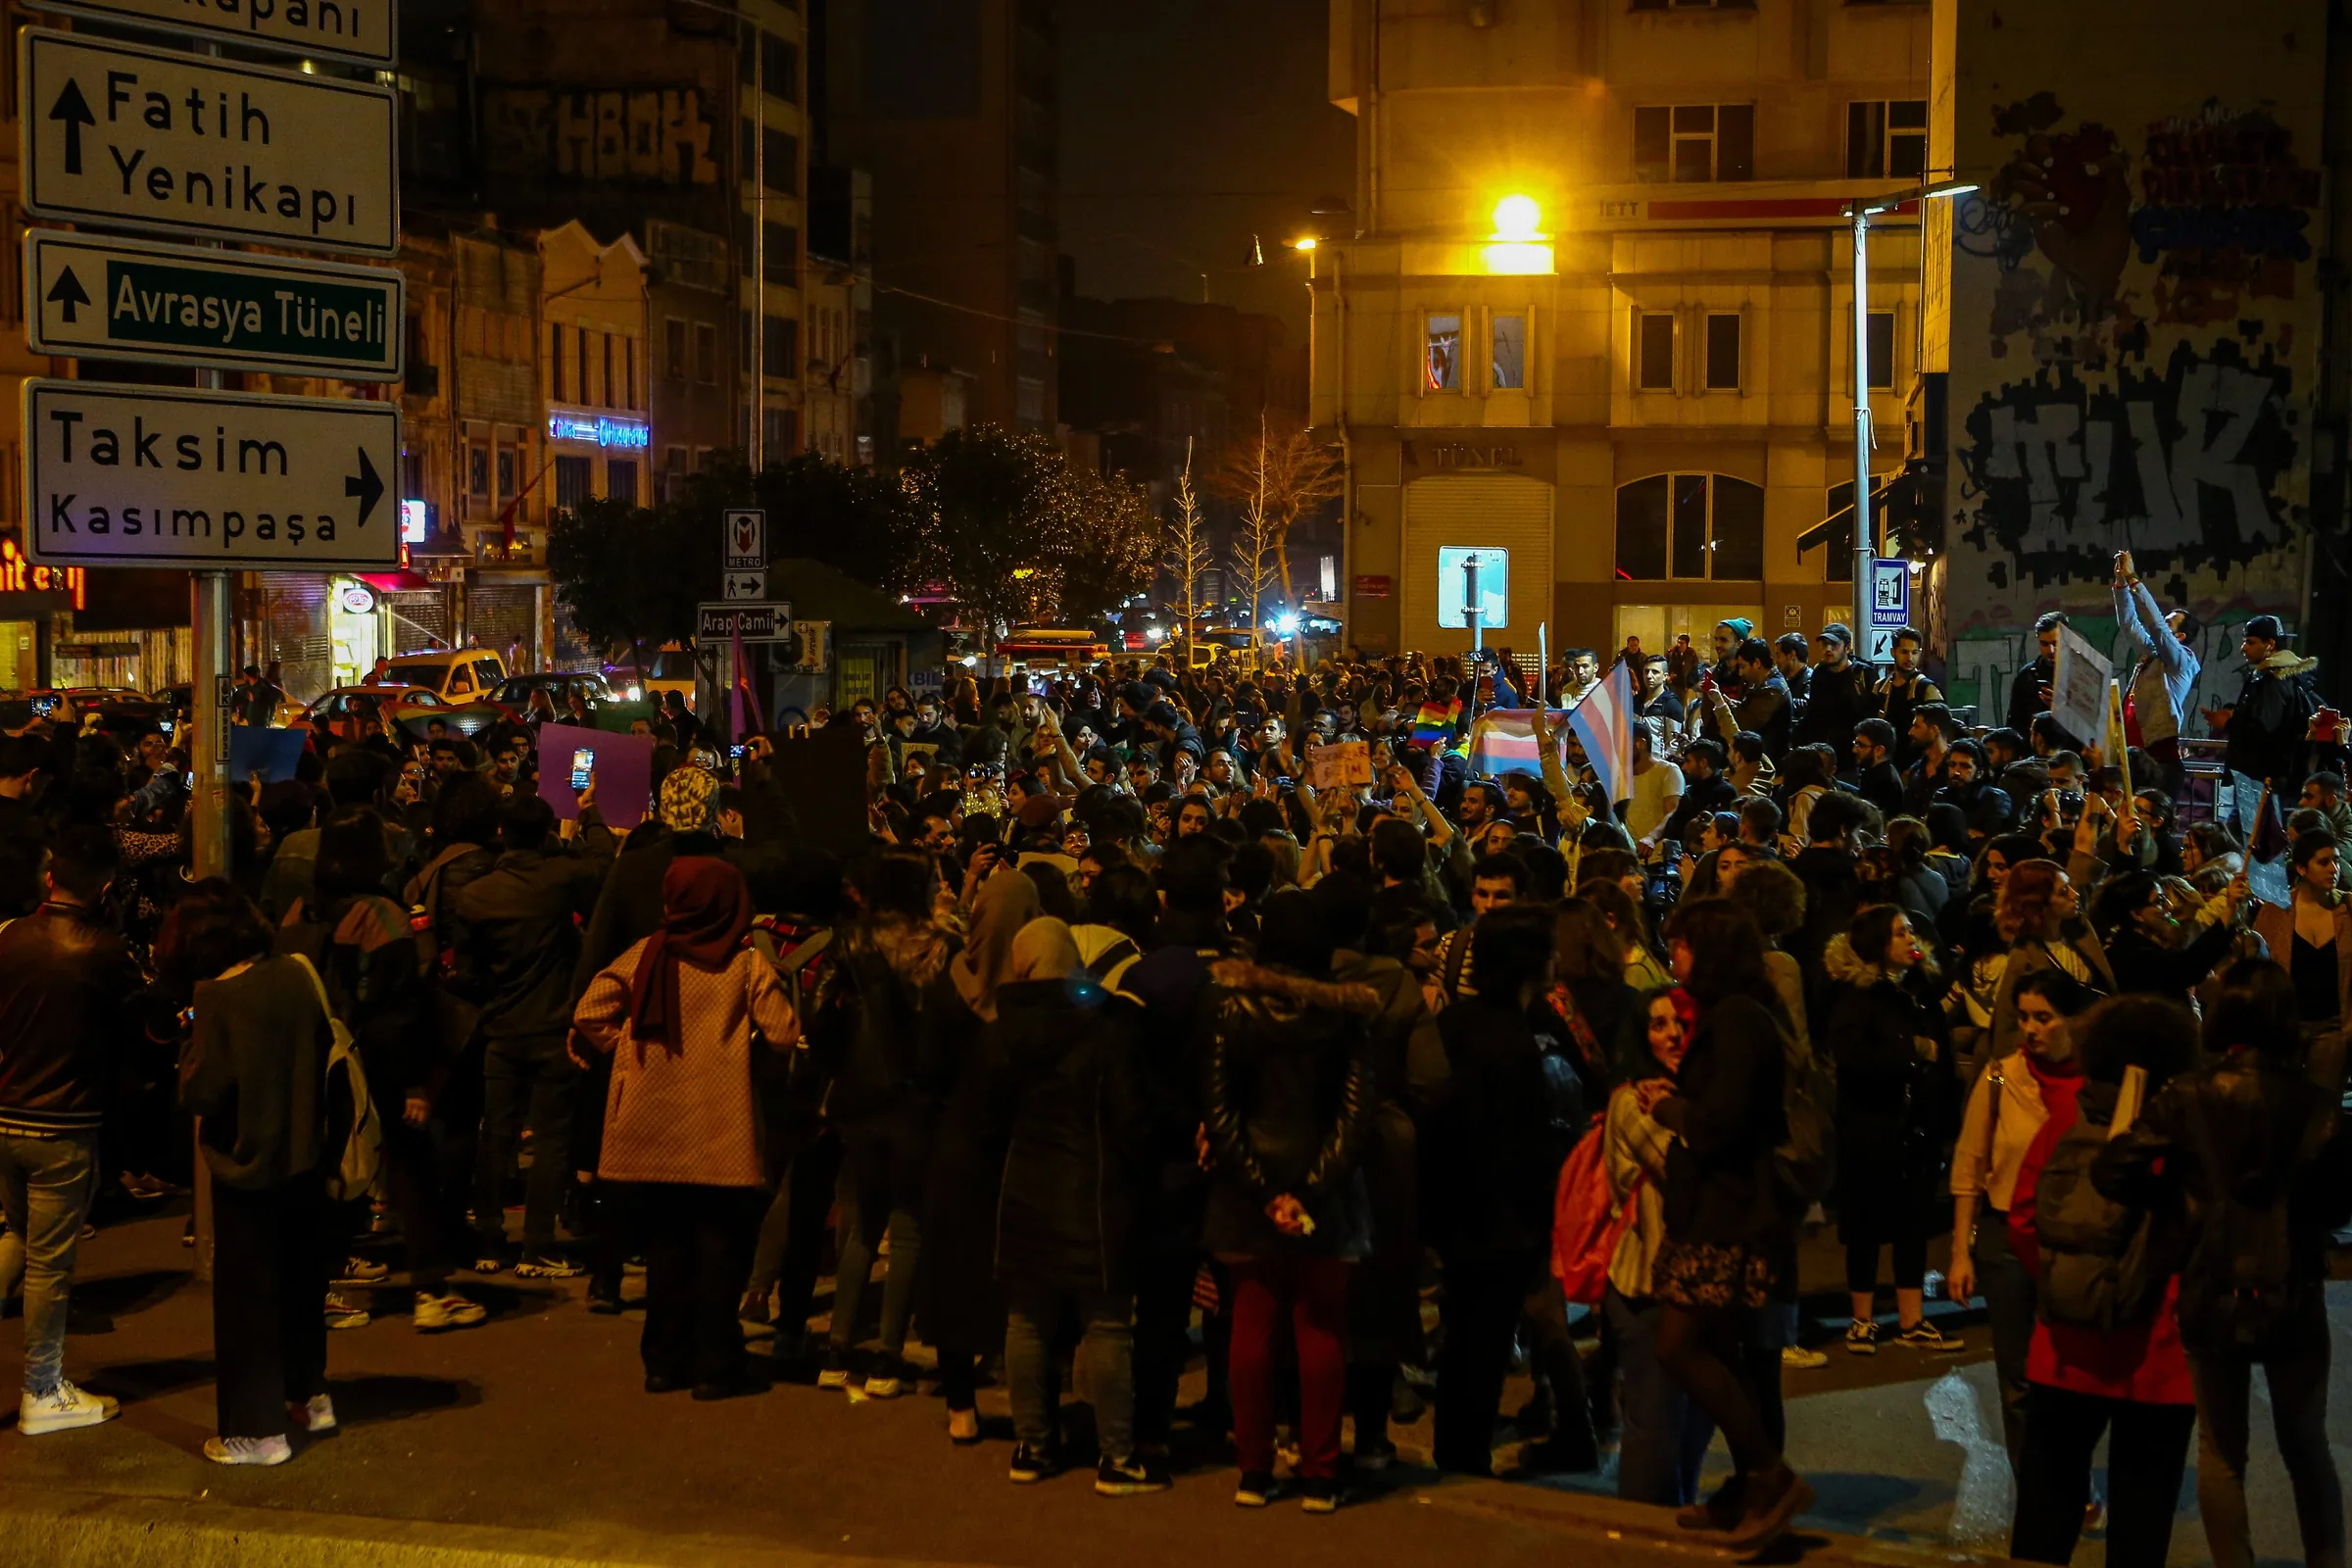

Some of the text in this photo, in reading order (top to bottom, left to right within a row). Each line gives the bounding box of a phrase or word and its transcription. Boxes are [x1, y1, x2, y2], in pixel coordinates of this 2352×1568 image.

[108, 71, 270, 144] Fatih
[108, 145, 355, 234] Yenikapı
[113, 273, 385, 345] Avrasya Tüneli
[51, 410, 287, 476] Taksim
[1432, 443, 1523, 466] TÜNEL
[51, 494, 336, 549] Kasımpaşa
[728, 558, 761, 567] METRO
[703, 611, 774, 636] Arap Camii
[1874, 612, 1906, 623] TRAMVAY
